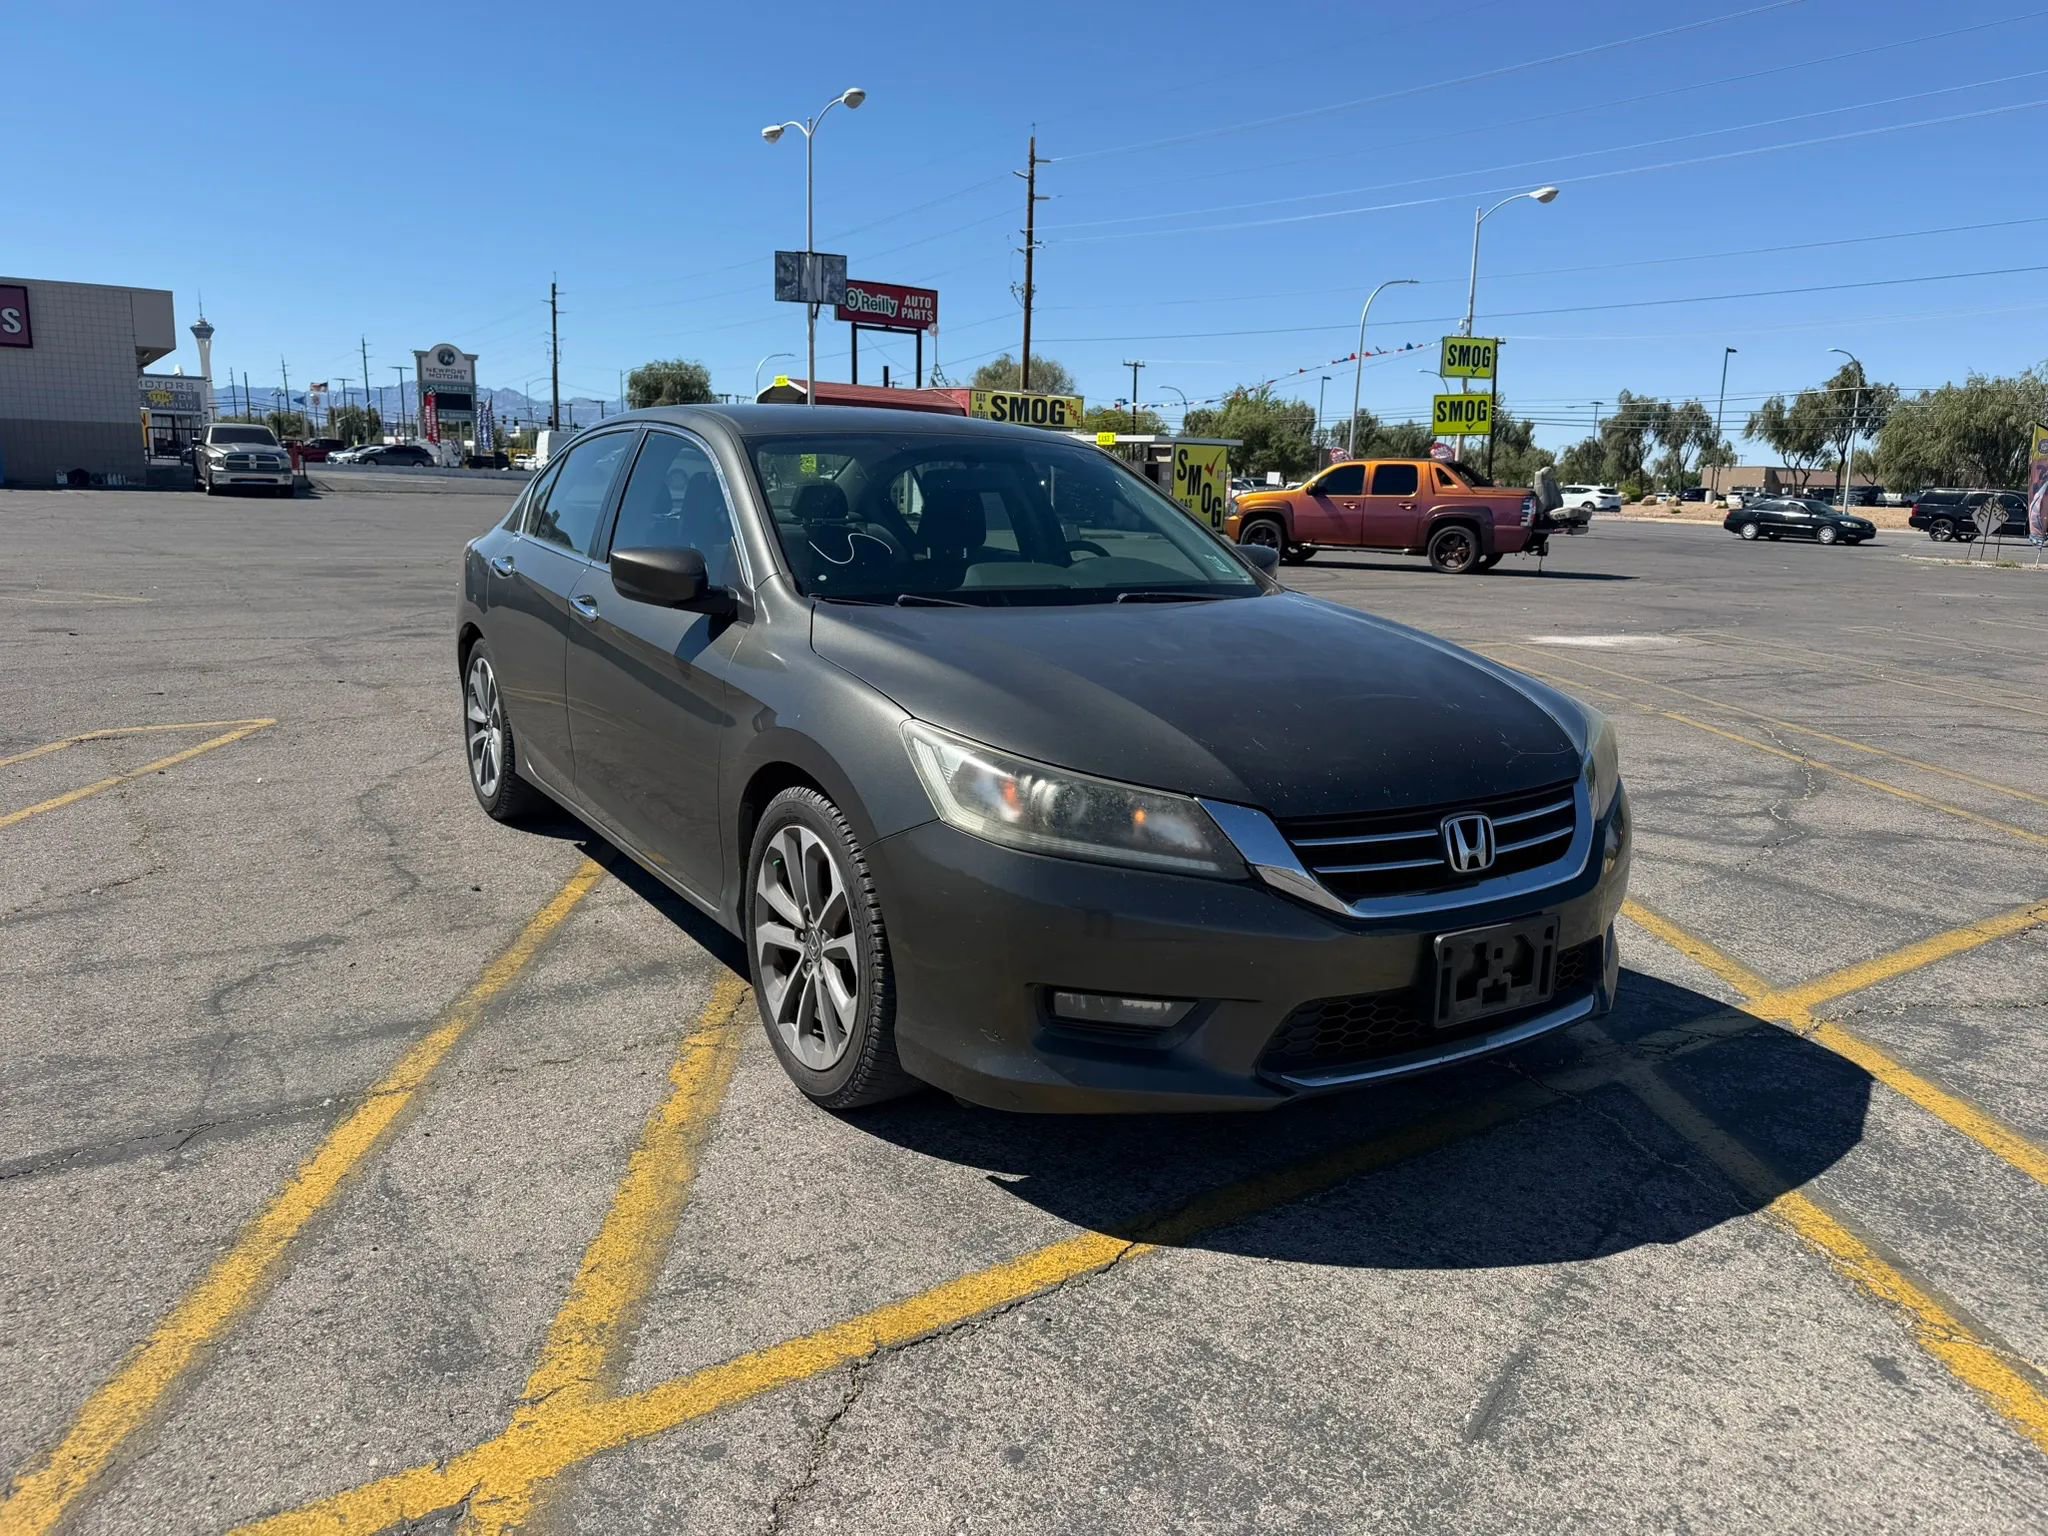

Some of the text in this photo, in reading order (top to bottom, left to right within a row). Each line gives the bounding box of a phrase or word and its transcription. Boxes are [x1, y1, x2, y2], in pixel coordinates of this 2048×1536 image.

[846, 288, 898, 317] O'Reilly
[904, 295, 931, 309] AUTO
[2, 307, 21, 333] S
[901, 308, 933, 322] PARTS
[1447, 344, 1491, 368] SMOG
[426, 367, 467, 375] NEWPORT
[991, 395, 1065, 425] SMOG
[1066, 400, 1081, 426] HERE
[1436, 400, 1487, 422] SMOG
[1177, 449, 1223, 528] SMOG
